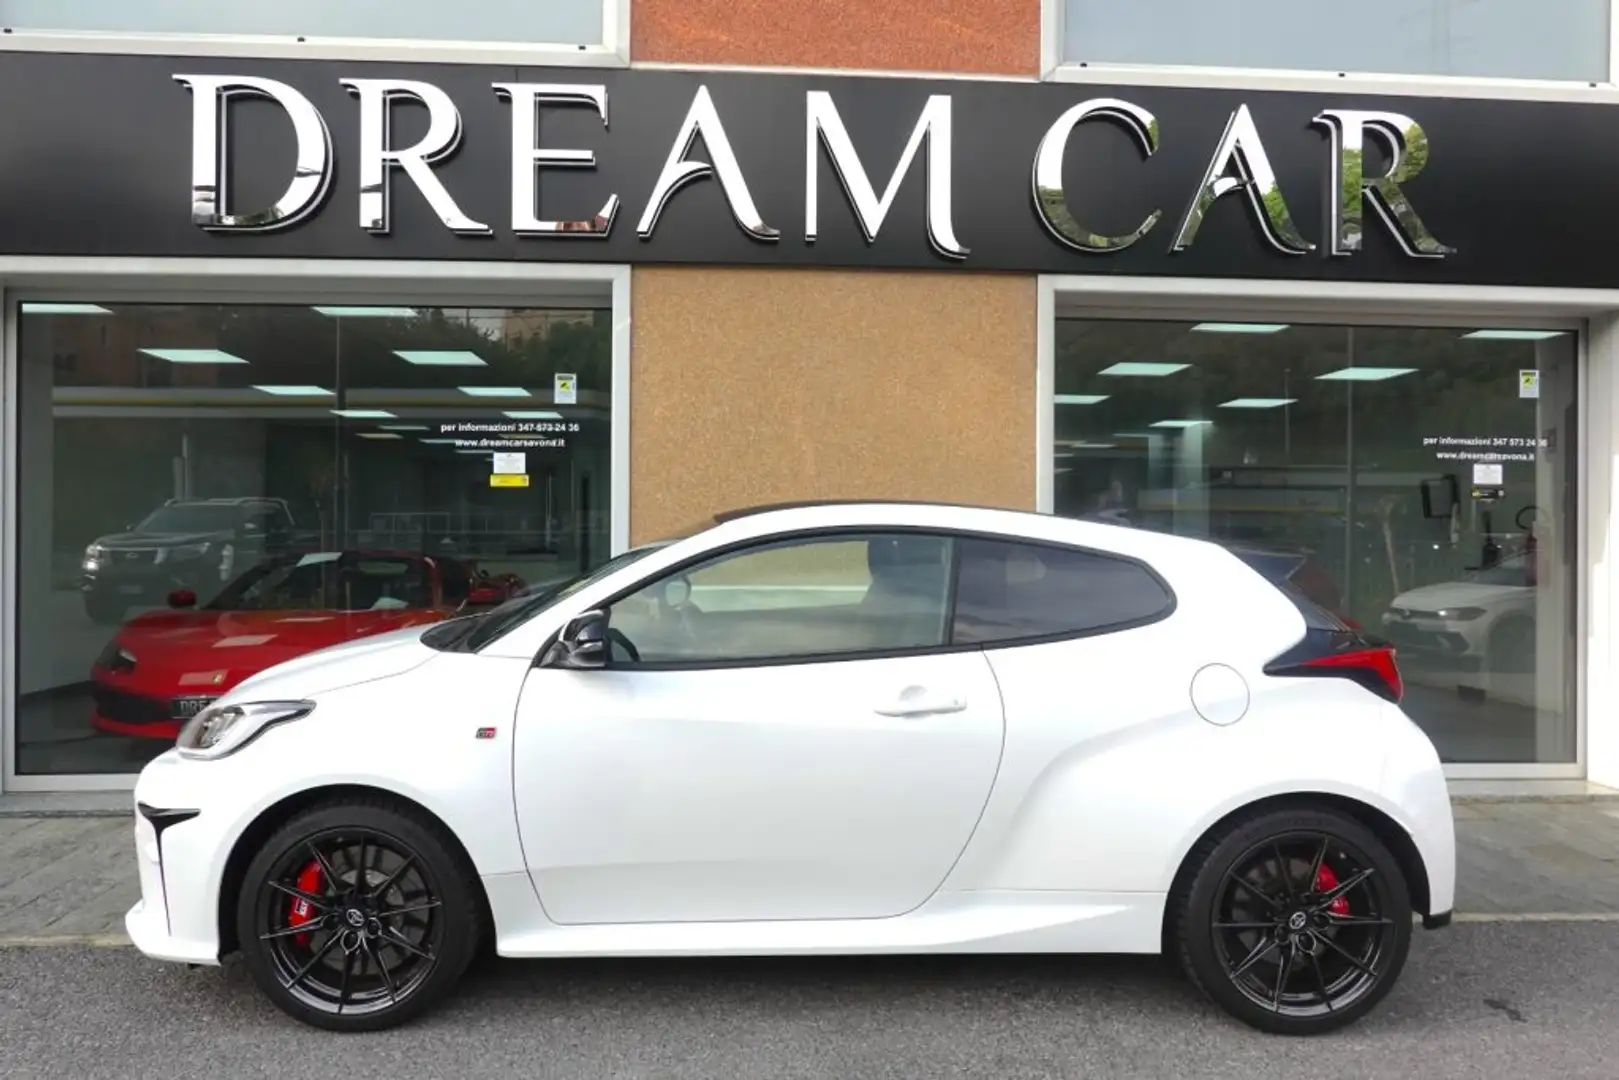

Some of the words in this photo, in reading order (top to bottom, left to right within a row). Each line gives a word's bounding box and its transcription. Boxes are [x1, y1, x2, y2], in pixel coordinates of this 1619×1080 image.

[172, 73, 970, 260] DREAM
[1031, 97, 1457, 259] CAR
[440, 424, 456, 433] per
[458, 422, 516, 432] informazioni
[454, 438, 565, 447] www.dreamcarsavona.it
[1423, 437, 1438, 446] per
[1439, 436, 1491, 445] informazioni
[1492, 437, 1508, 446] 347
[1509, 438, 1524, 447] 573
